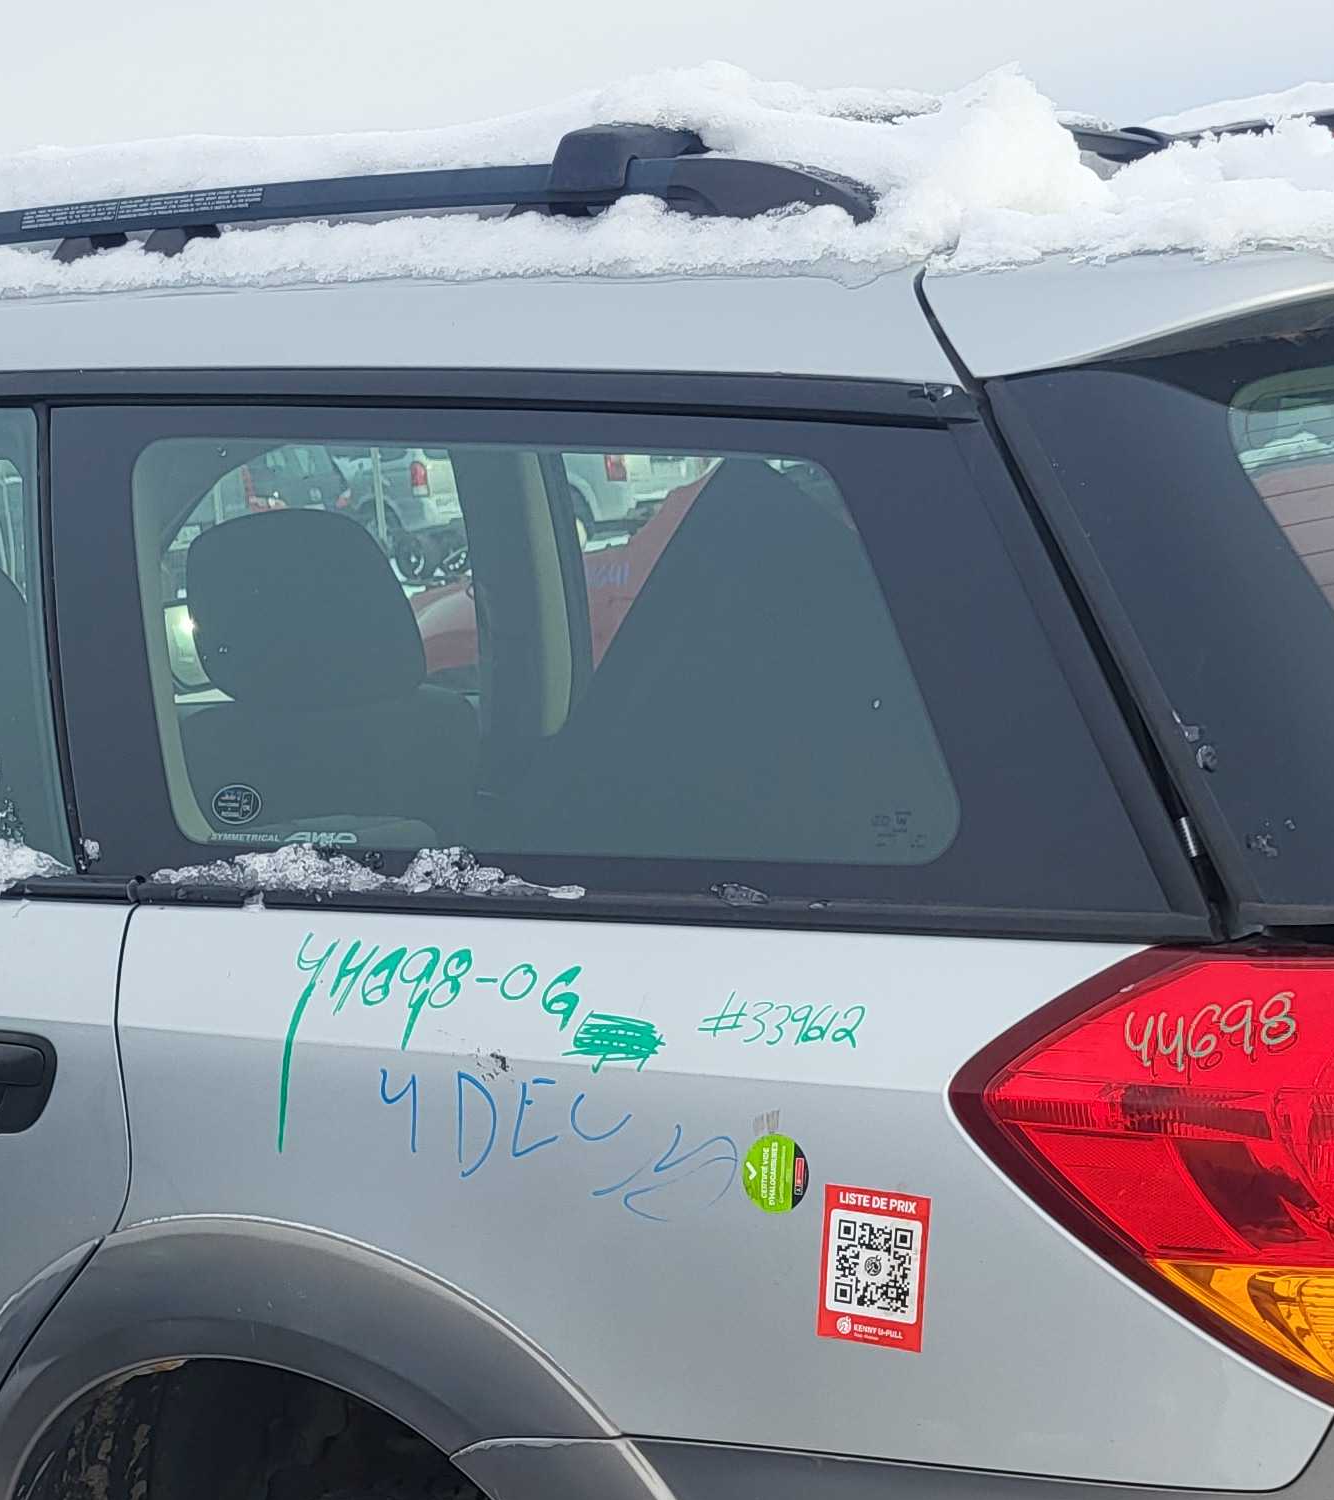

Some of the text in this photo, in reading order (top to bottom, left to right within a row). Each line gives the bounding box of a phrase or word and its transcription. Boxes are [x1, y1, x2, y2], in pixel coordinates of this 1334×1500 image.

[211, 831, 357, 844] SYMMETRICAL AWD
[1124, 991, 1295, 1072] 44698
[456, 1070, 633, 1179] DEC
[839, 1191, 918, 1214] LISTE DE PRIX
